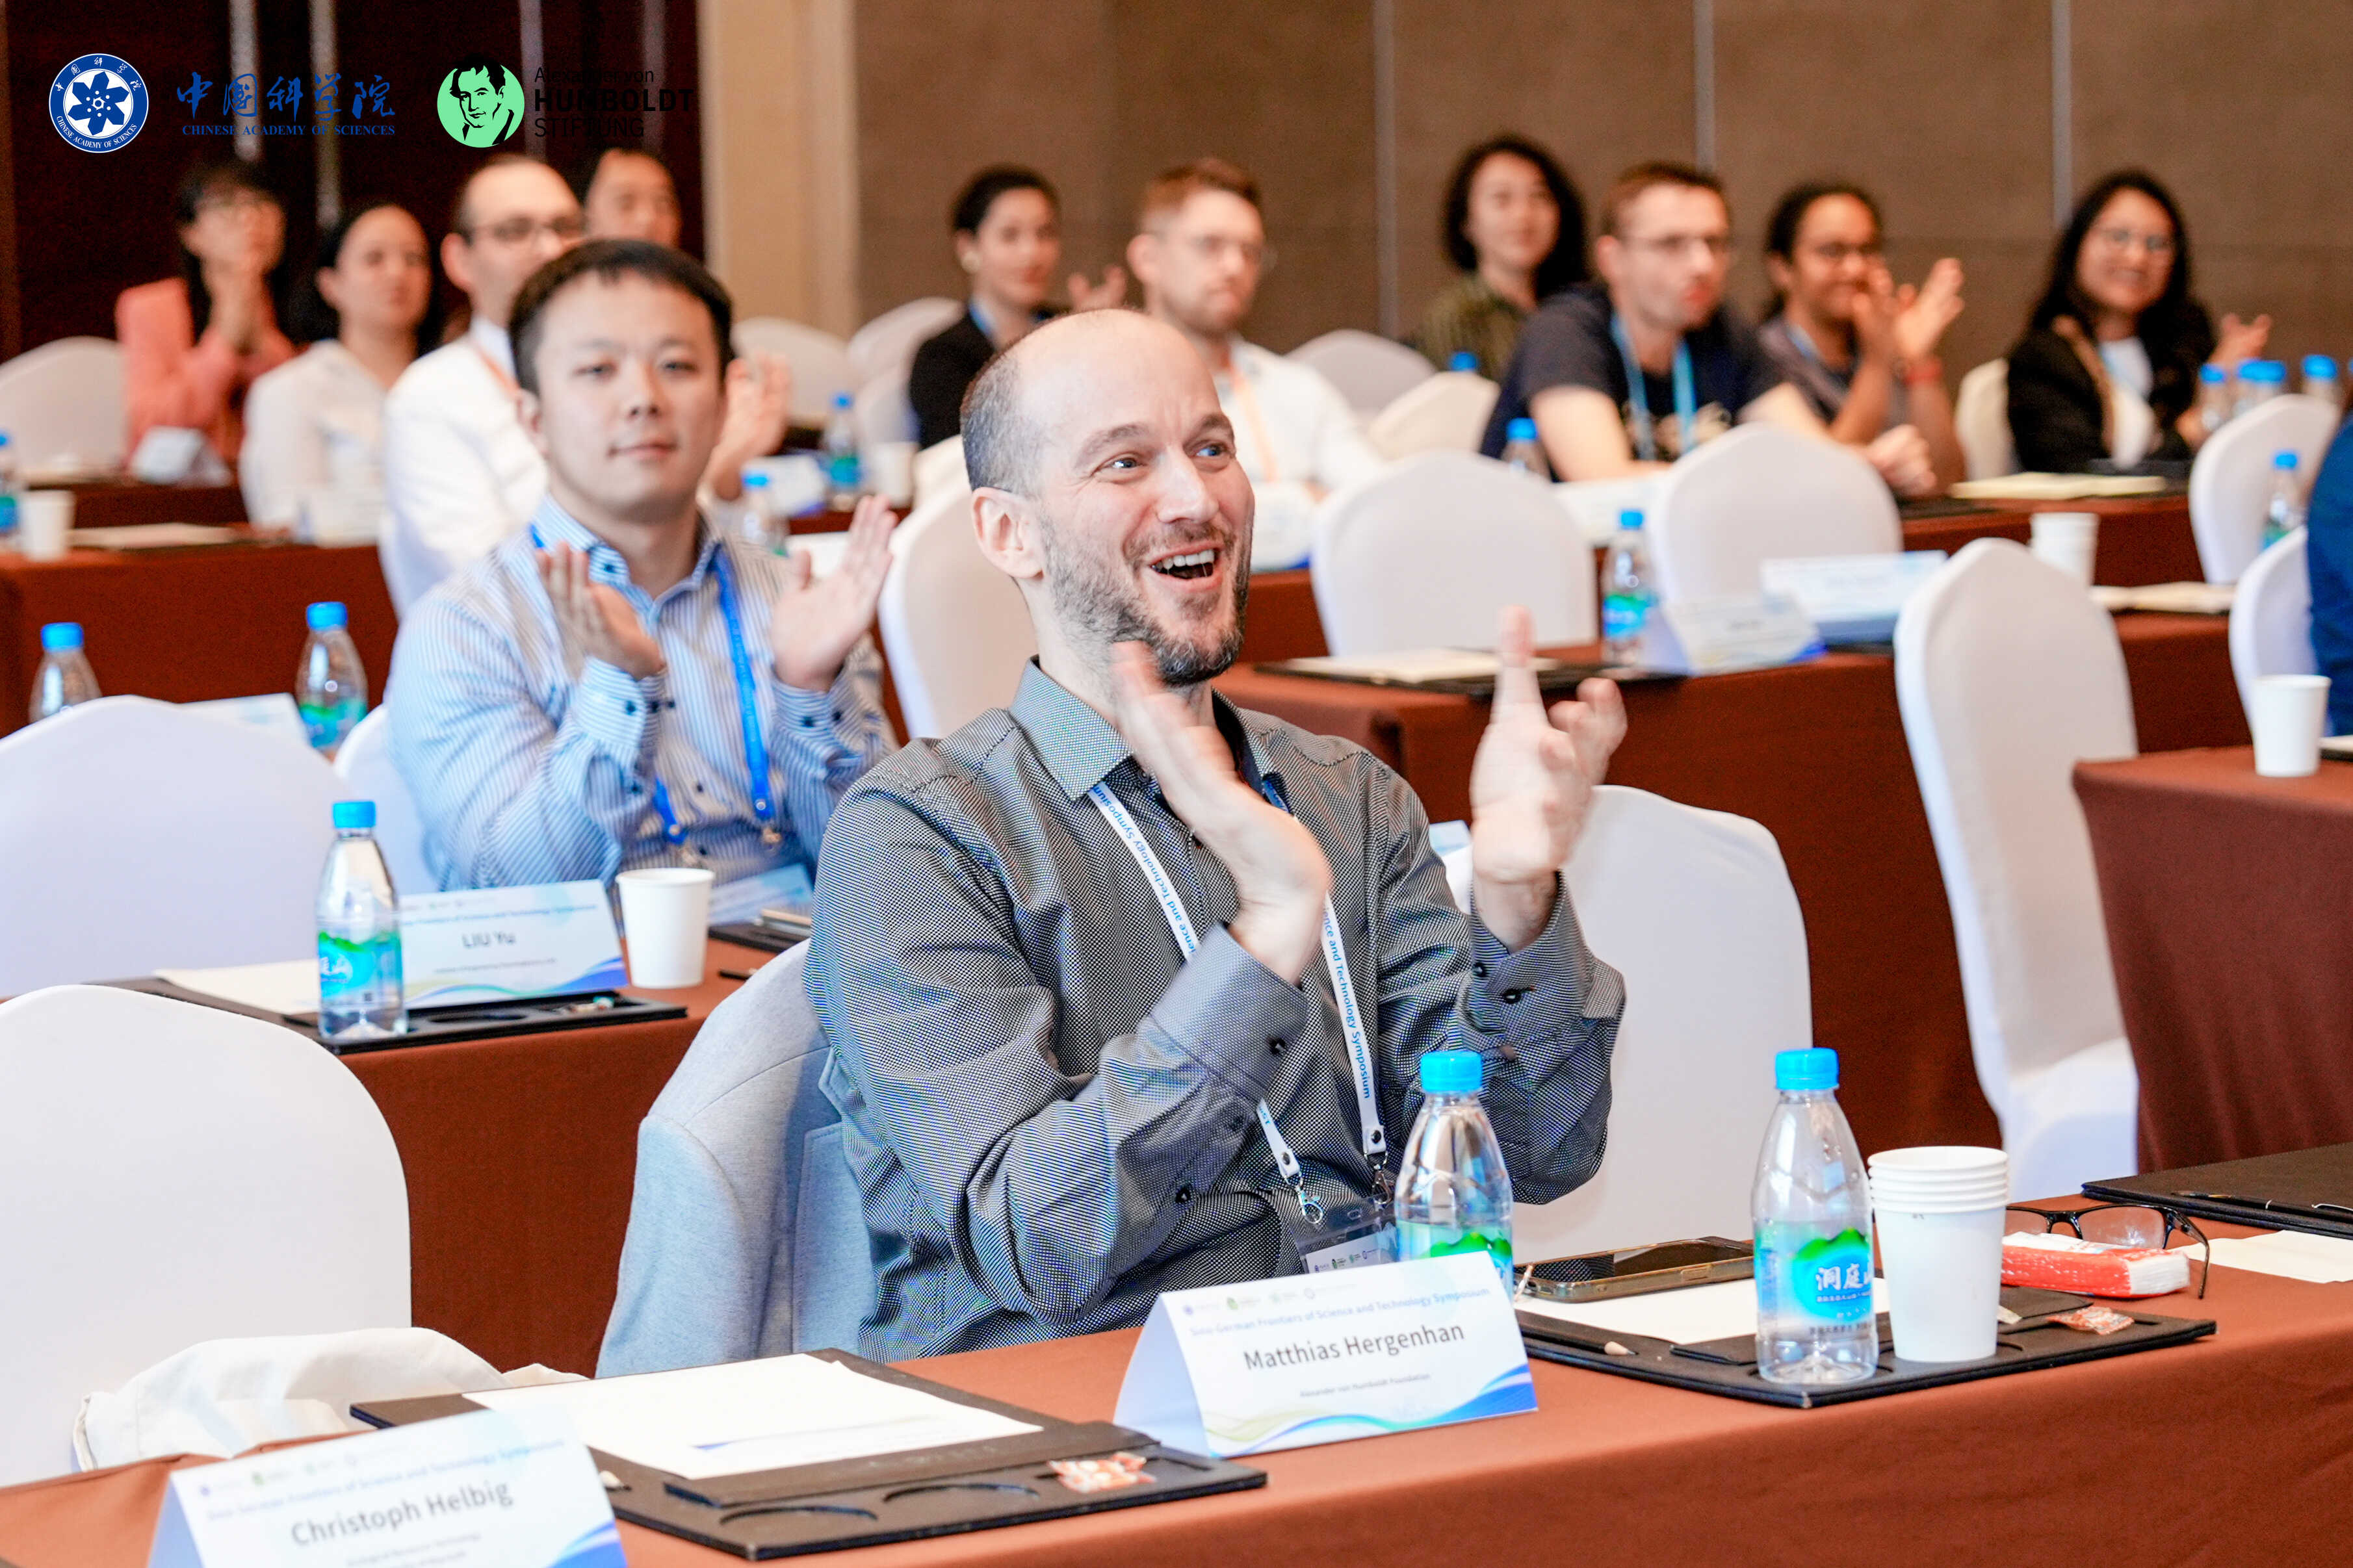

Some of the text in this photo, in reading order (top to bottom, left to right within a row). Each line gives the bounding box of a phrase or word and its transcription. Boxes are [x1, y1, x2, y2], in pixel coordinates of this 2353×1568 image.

[1093, 786, 1197, 955] ience and Technology Symposium
[462, 931, 517, 949] LIU Yu
[1329, 939, 1342, 962] and
[1335, 965, 1357, 1029] Technology
[1351, 1031, 1372, 1099] Symposium
[1316, 1307, 1353, 1319] Science
[1356, 1302, 1374, 1314] and
[1376, 1296, 1431, 1311] Technology
[1432, 1288, 1490, 1304] Symposium
[1243, 1324, 1465, 1370] Matthias Hergenhan
[291, 1497, 422, 1545] Christoph
[425, 1479, 514, 1517] Helbig
